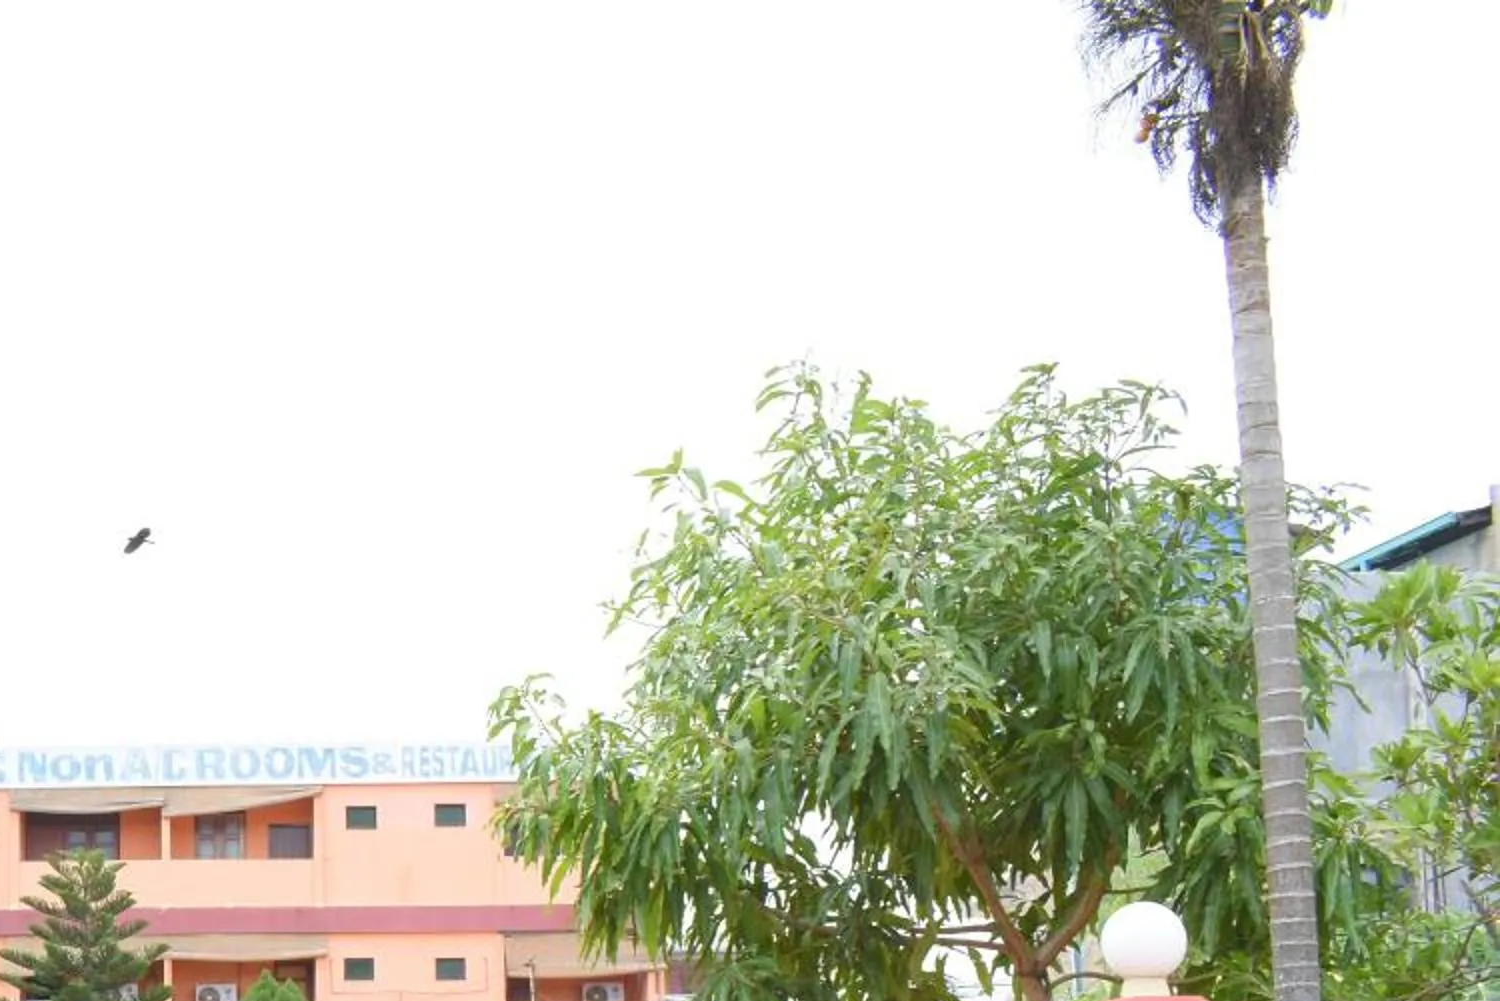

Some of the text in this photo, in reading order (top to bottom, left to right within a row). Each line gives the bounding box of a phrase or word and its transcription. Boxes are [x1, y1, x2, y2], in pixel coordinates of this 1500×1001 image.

[18, 750, 113, 783] Non
[194, 746, 373, 780] ROOMS
[373, 750, 398, 775] &
[403, 745, 515, 778] RESTAUR
